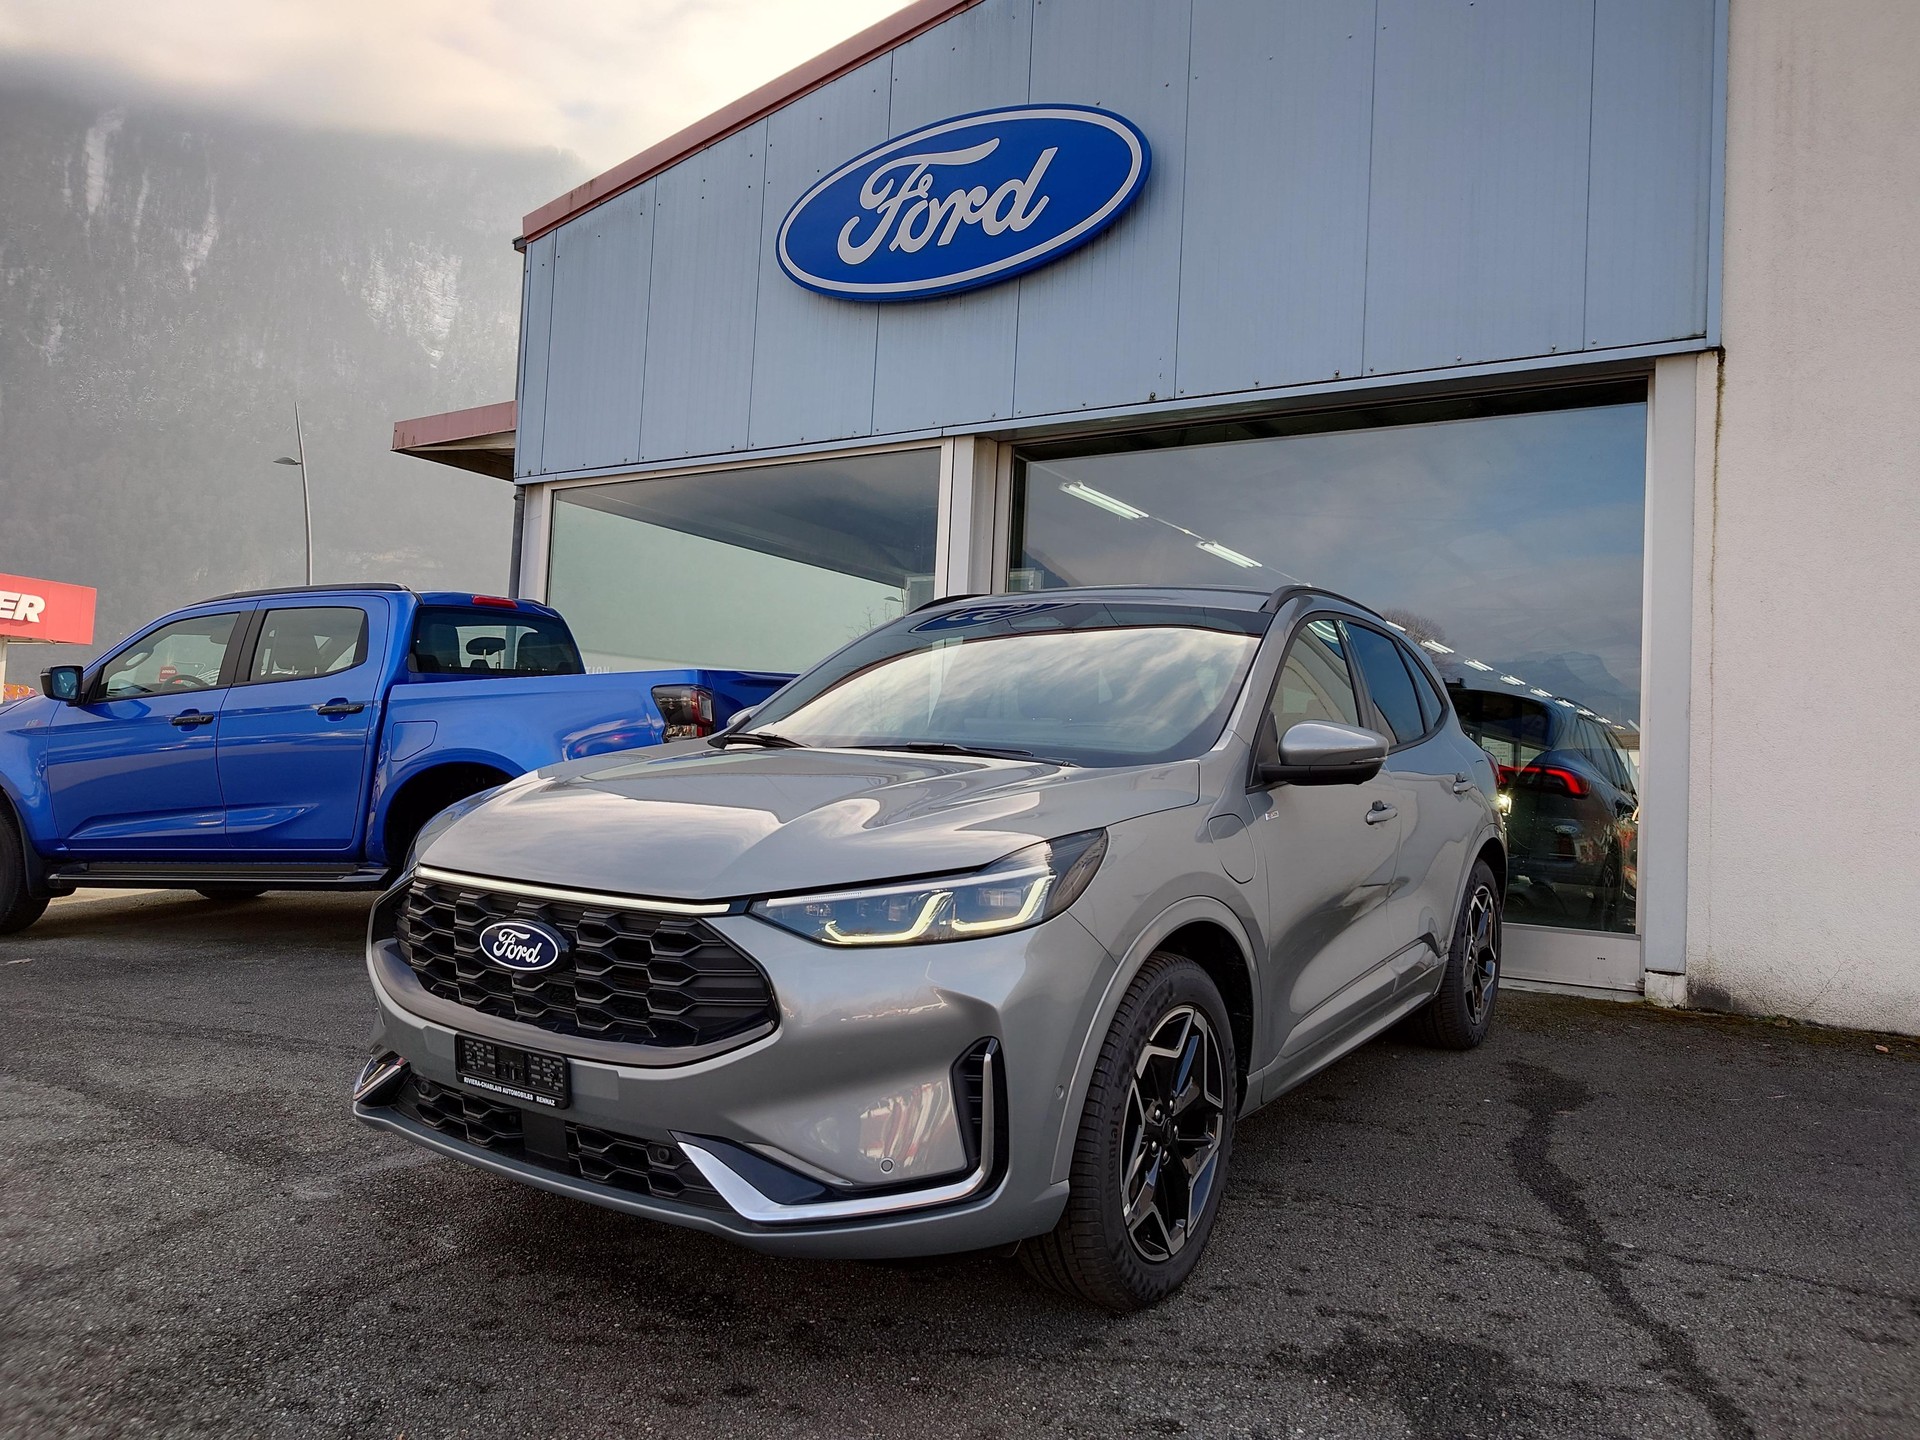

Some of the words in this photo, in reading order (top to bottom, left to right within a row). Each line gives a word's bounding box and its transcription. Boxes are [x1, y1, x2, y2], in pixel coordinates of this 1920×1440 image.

[837, 137, 1059, 265] Ford
[0, 590, 46, 623] ER
[493, 928, 542, 963] Ford
[464, 1077, 501, 1092] RIVIERA-CHABLAIS
[502, 1087, 533, 1100] AUTOMOBILES
[536, 1096, 555, 1106] RENNAZ
